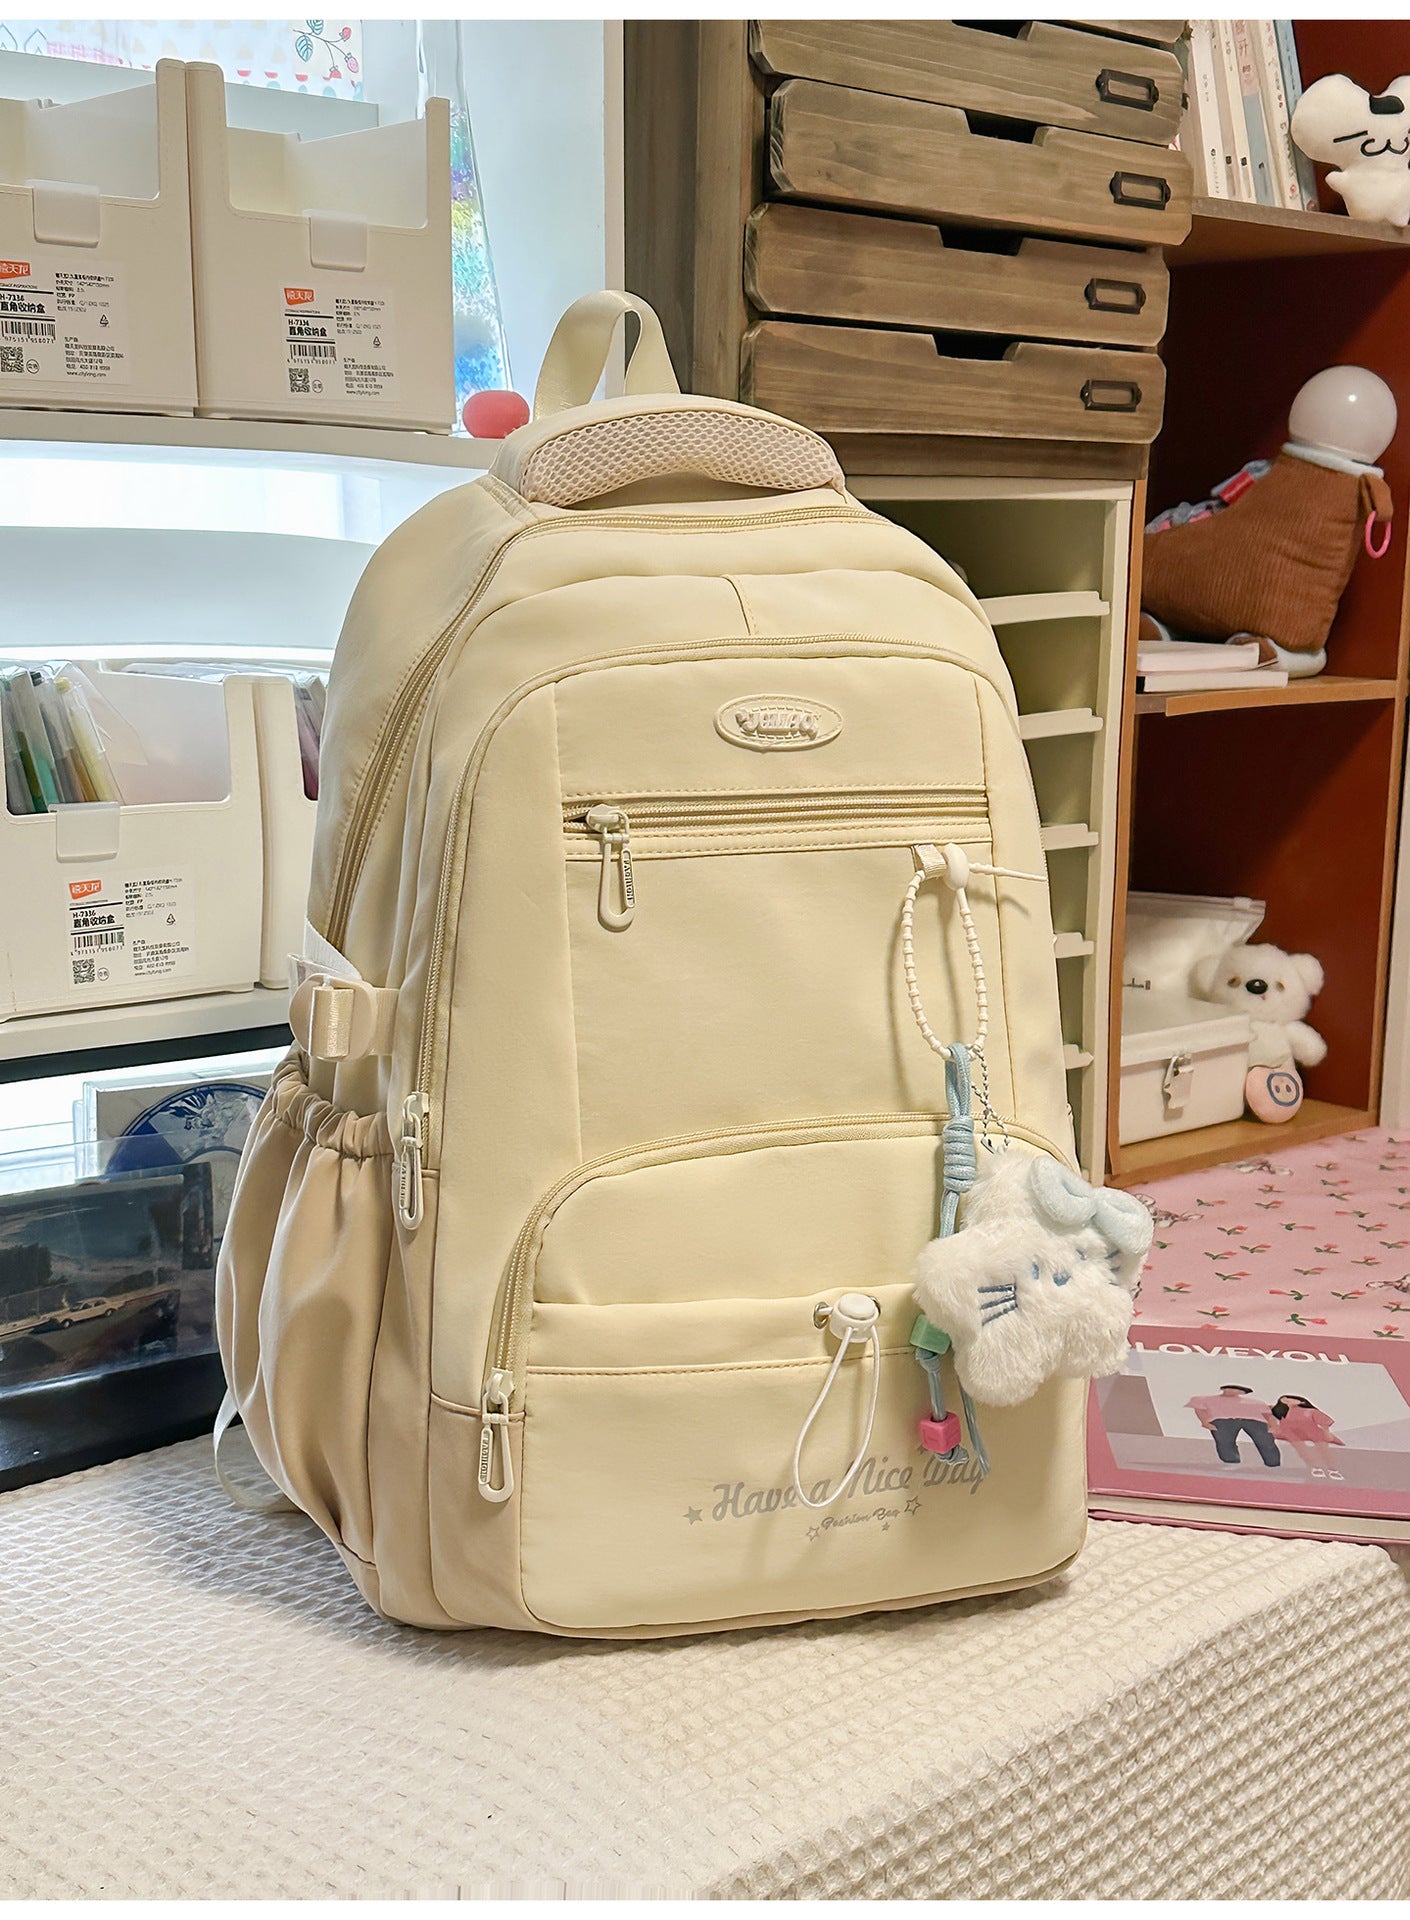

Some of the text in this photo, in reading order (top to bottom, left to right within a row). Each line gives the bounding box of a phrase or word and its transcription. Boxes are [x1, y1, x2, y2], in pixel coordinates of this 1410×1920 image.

[712, 1453, 984, 1521] Have a Nice Day
